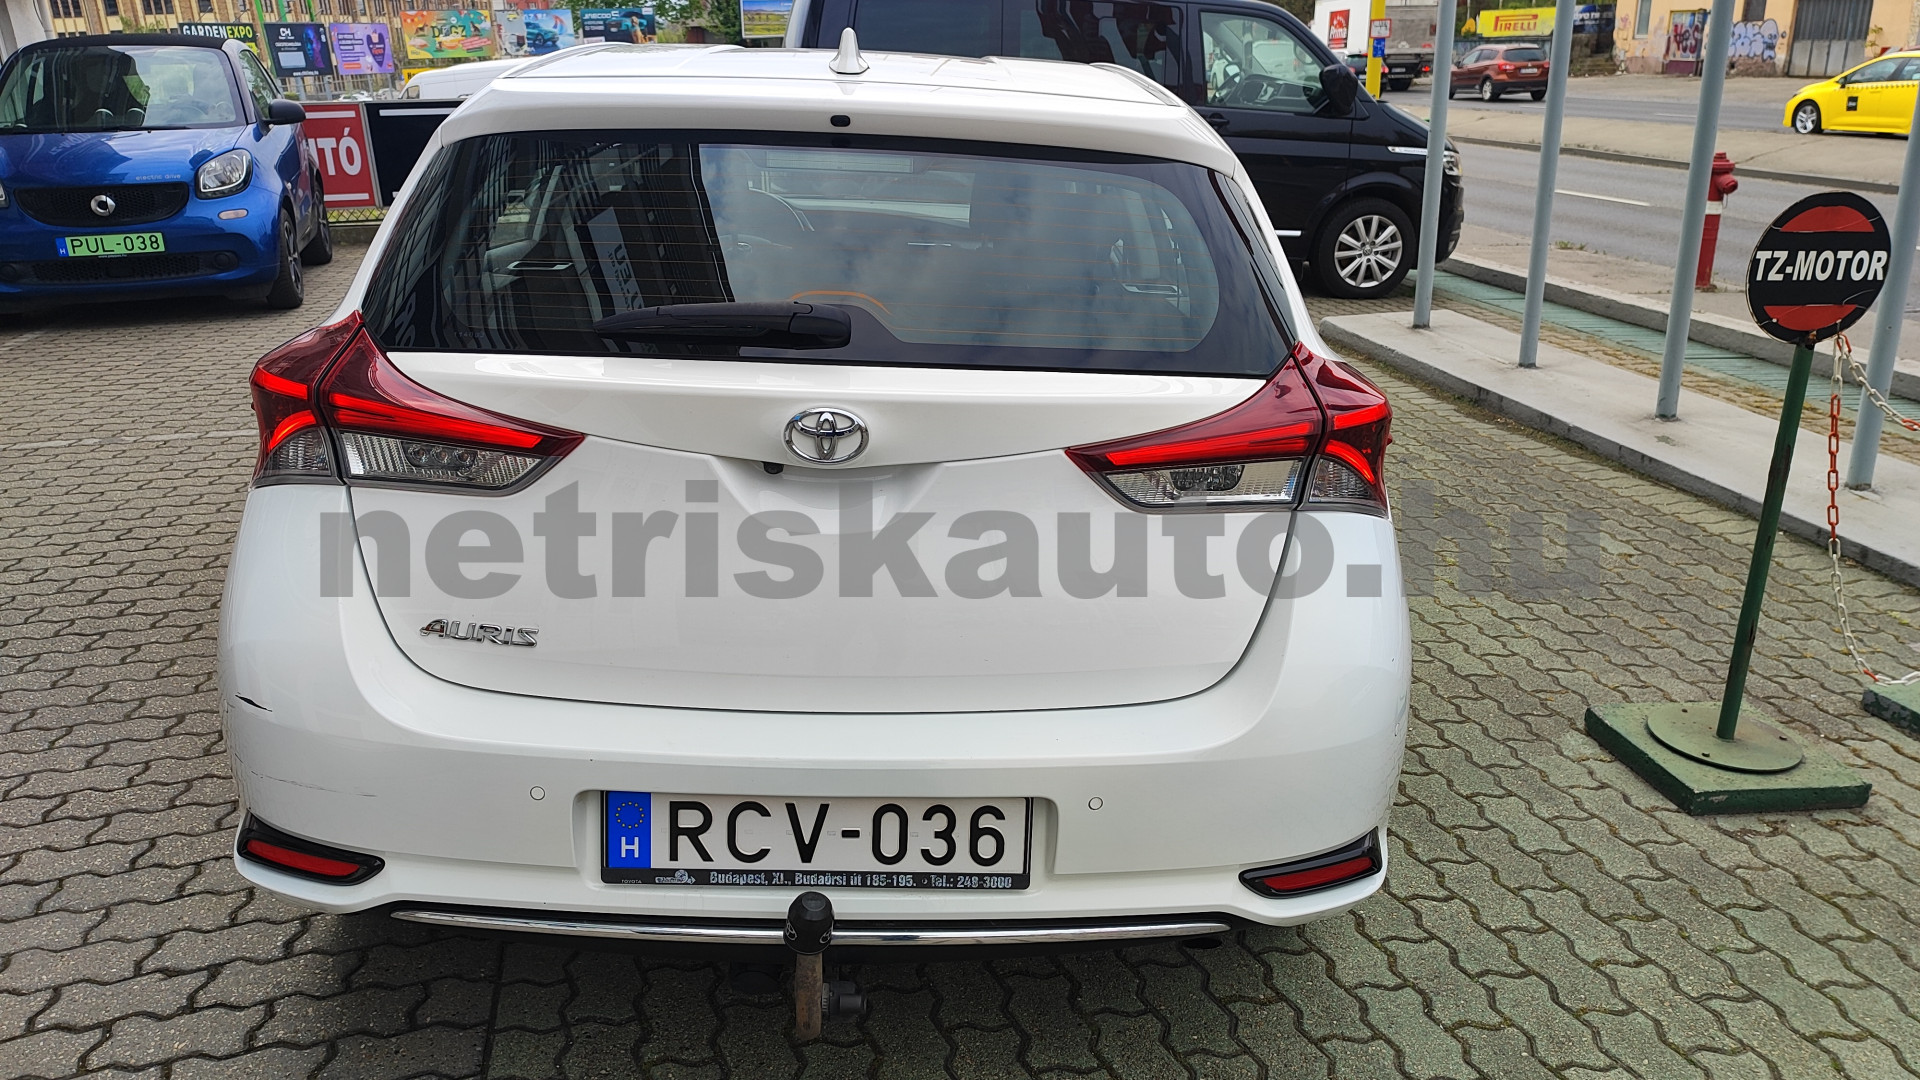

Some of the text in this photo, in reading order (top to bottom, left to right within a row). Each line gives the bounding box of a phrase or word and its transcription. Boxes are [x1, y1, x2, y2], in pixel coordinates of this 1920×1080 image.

[182, 25, 253, 39] GARDENEXPO
[1493, 14, 1538, 32] PIRELLI
[59, 234, 160, 255] H PUL-038
[1755, 250, 1888, 281] TZ-MOTOR
[419, 618, 540, 647] AURIS
[621, 801, 1006, 867] H RCV-036
[709, 871, 769, 886] Budapest,
[795, 871, 847, 886] Budaörsi
[850, 872, 862, 886] út
[866, 873, 917, 887] 185-195.
[930, 874, 953, 888] Tel.:
